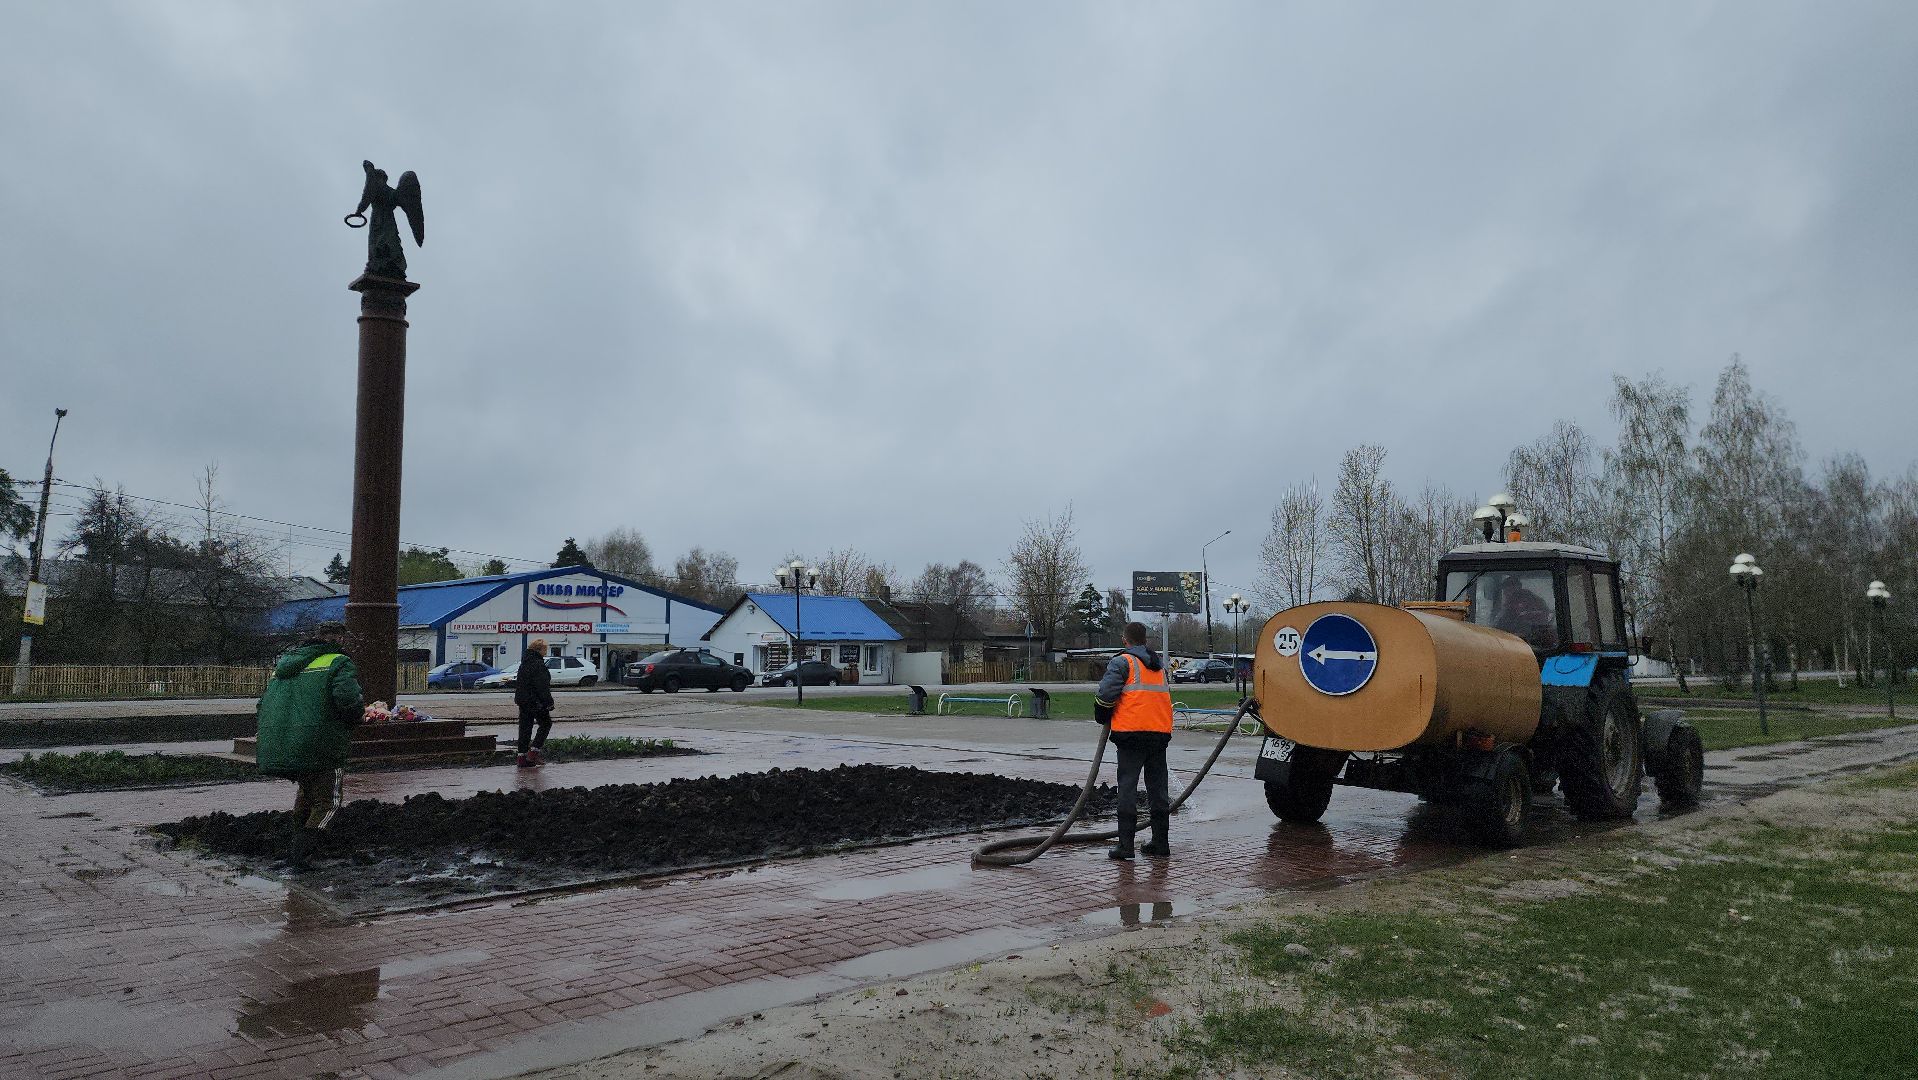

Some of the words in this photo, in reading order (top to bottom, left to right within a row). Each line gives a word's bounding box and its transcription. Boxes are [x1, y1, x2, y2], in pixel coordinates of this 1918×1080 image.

[537, 584, 573, 596] АКВА
[576, 585, 624, 598] МАСТЕР
[500, 623, 591, 632] НЕДОРОГАЯ-МЕБЕЛЬ.РФ
[1279, 634, 1298, 649] 25
